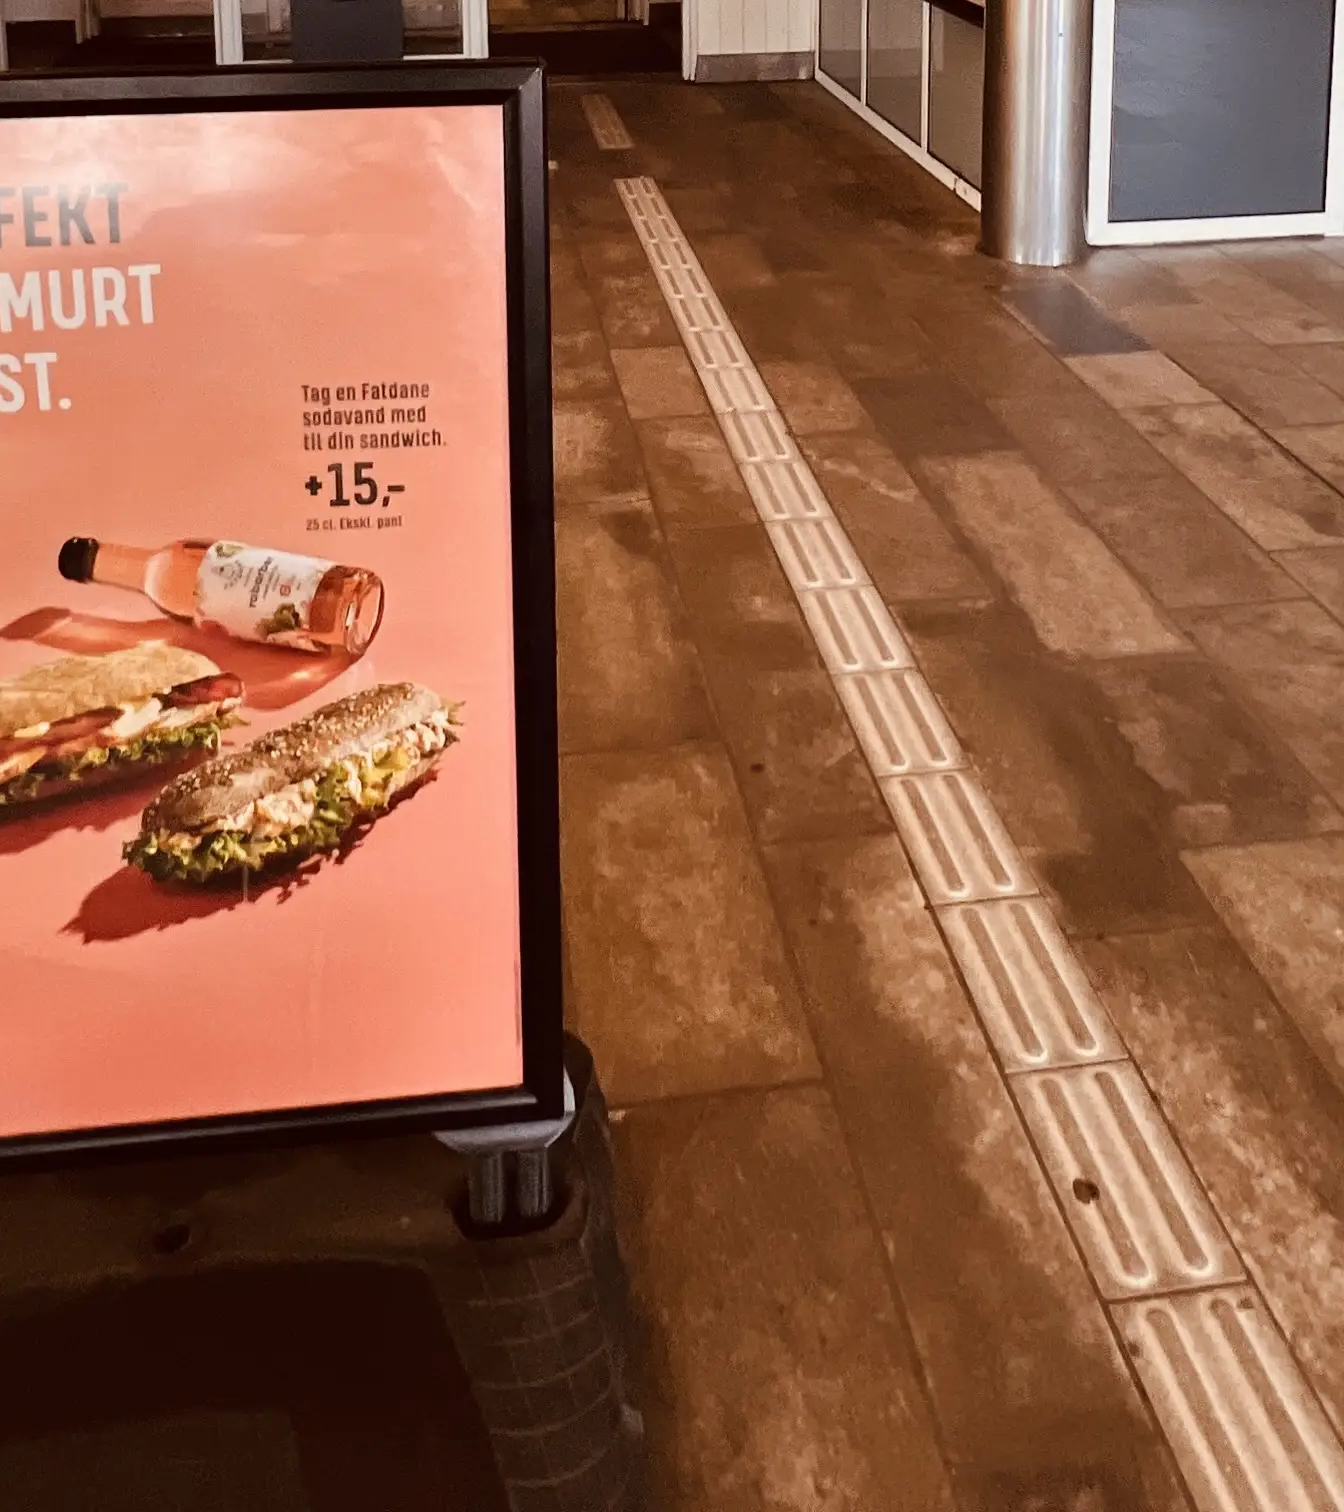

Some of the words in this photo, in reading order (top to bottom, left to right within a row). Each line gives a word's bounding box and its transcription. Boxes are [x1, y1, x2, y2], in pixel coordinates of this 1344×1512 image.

[300, 383, 332, 407] Tag
[335, 386, 357, 402] en
[360, 381, 430, 402] Fatdane
[302, 405, 386, 428] sodavand
[390, 404, 427, 425] med
[303, 431, 324, 452] til
[327, 430, 355, 451] din
[359, 427, 448, 450] sandwich.
[306, 517, 320, 532] 25
[376, 515, 404, 530] pant
